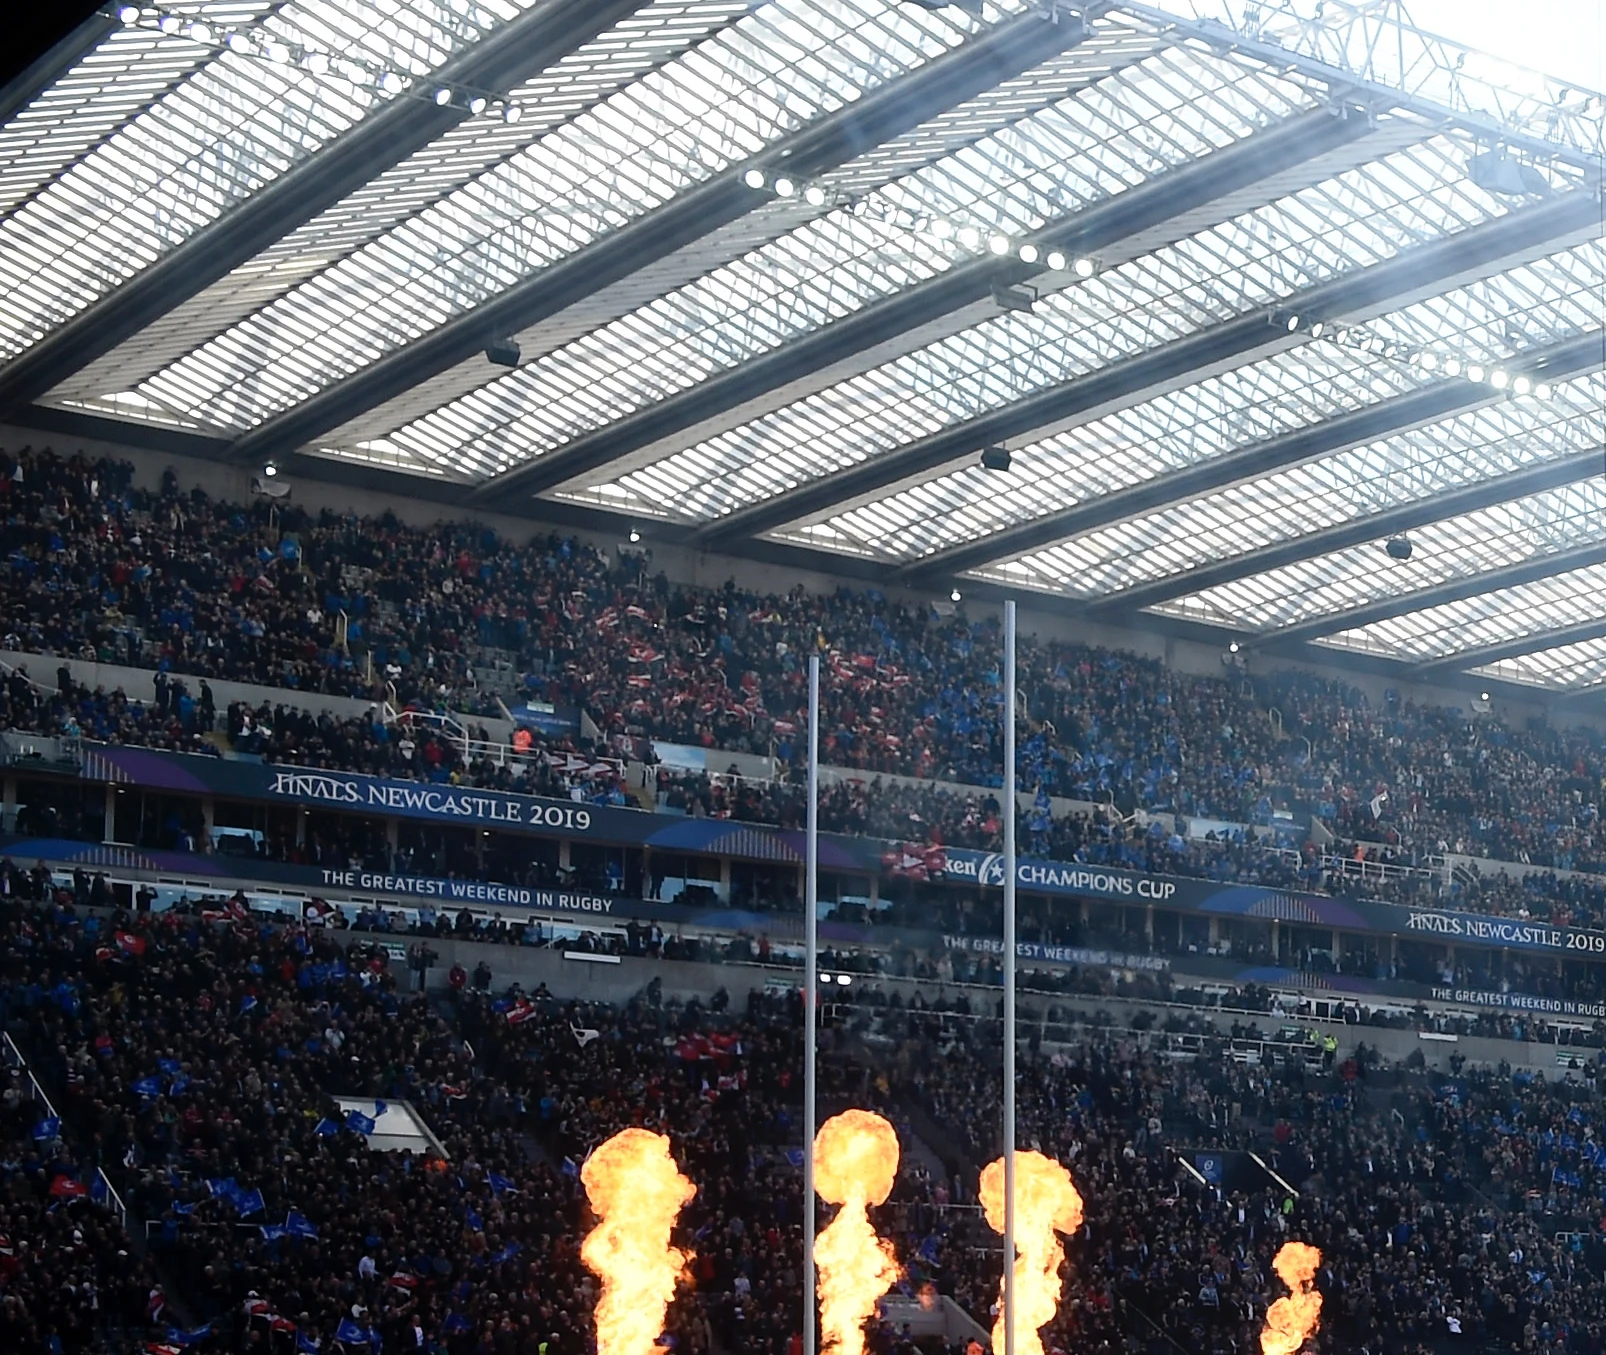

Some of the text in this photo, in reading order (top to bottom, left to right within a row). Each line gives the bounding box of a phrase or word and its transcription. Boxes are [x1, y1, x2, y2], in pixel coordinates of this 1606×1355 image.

[269, 773, 591, 830] FINALS NEWCASTLE 2019
[322, 870, 613, 912] THE GREATEST WEEKEND IN RUGBY
[1018, 865, 1176, 899] CHAMPIONS CUP
[1406, 912, 1605, 953] FINALS NEWCASTLE 2019
[1431, 988, 1452, 1000] THE
[1455, 990, 1507, 1006] GREATEST
[1511, 995, 1561, 1013] WEEKEND
[1564, 1001, 1575, 1013] IN
